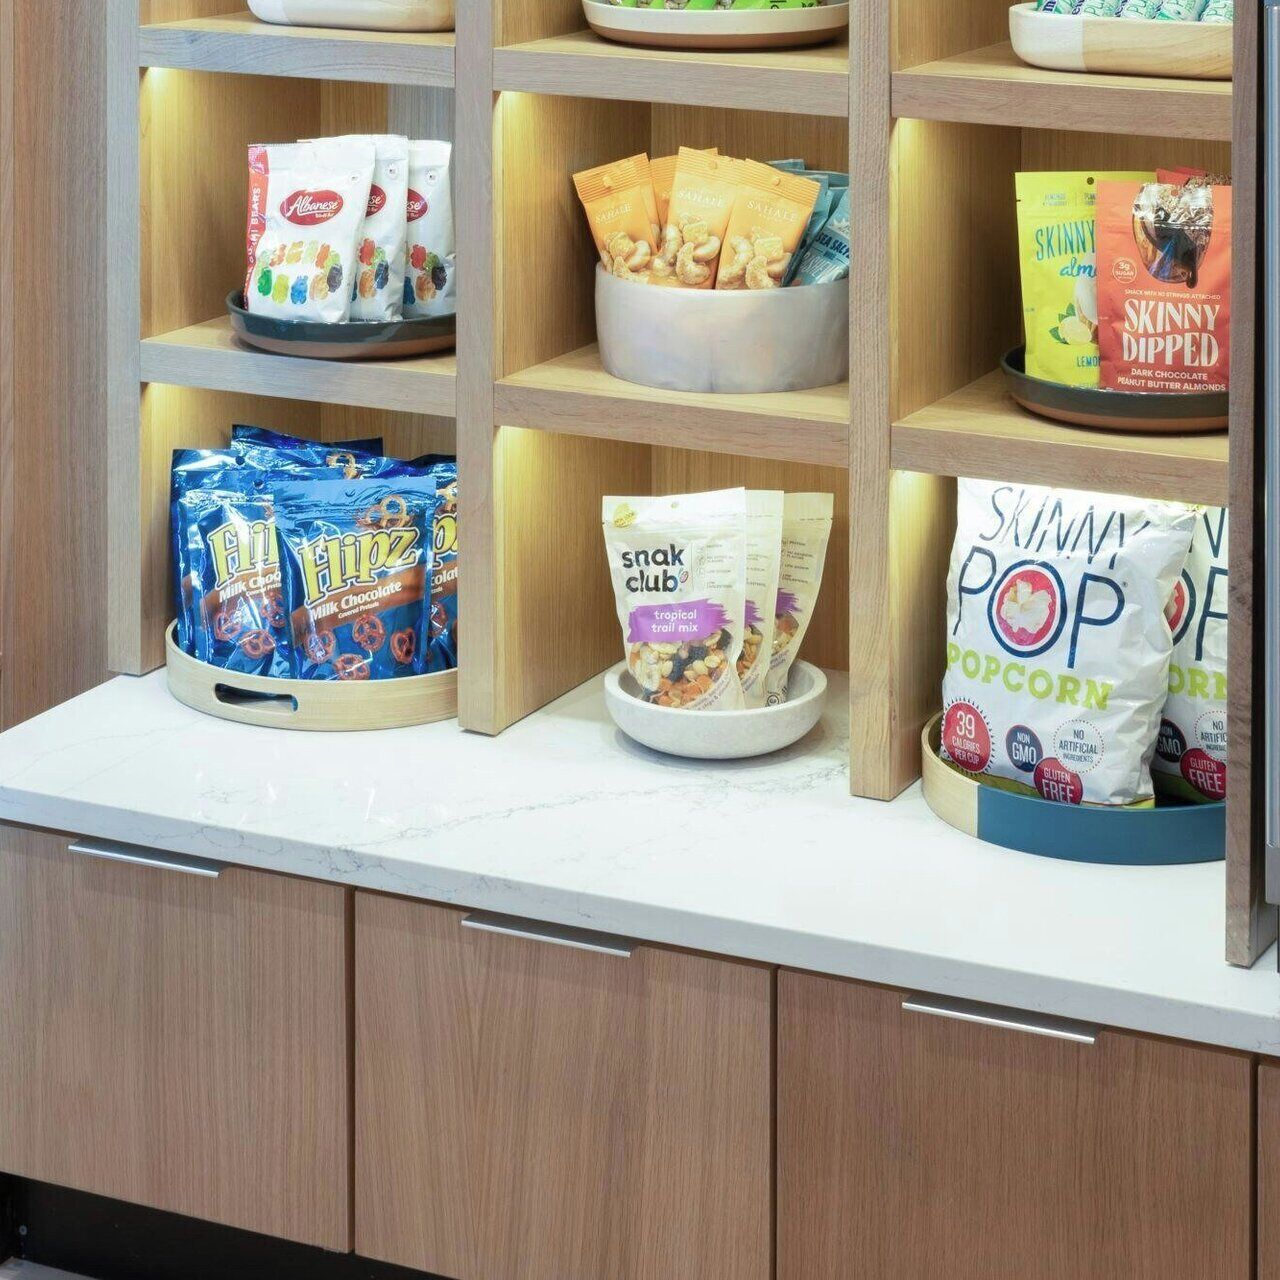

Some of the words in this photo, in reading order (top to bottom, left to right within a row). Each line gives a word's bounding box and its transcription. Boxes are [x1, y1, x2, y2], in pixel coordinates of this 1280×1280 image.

[285, 194, 339, 216] Albanese
[677, 189, 724, 207] SAHALE
[747, 200, 798, 222] SAHALE
[1035, 219, 1096, 261] SKINNY
[1124, 298, 1220, 334] SKINNY
[1122, 331, 1219, 367] DIPPED
[1117, 376, 1146, 387] PEANUT
[1147, 379, 1181, 390] BUTTER
[1182, 381, 1226, 391] ALMONDS
[1131, 368, 1154, 378] DARK
[1155, 370, 1208, 381] CHOCOLATE
[979, 486, 1150, 570] SKINNY
[622, 543, 685, 569] snak
[298, 527, 423, 609] Flipz
[625, 569, 679, 593] club
[219, 583, 248, 602] Milk
[311, 602, 339, 621] Milk
[340, 581, 403, 609] Chocolate
[338, 607, 358, 620] Covered
[356, 601, 380, 614] Pretzels
[654, 608, 698, 622] tropical
[953, 545, 1126, 669] POP
[651, 621, 676, 633] trail
[678, 622, 699, 633] mix
[946, 642, 1114, 711] POPCORN
[956, 710, 976, 739] 39
[1073, 729, 1085, 740] NO
[1212, 720, 1224, 731] NO
[951, 735, 981, 754] CALORIES
[1016, 731, 1031, 745] NON
[1058, 739, 1099, 755] ARTIFICIAL
[954, 747, 967, 761] PER
[967, 751, 980, 765] CUP
[1011, 742, 1037, 765] GMO
[1062, 753, 1094, 763] INGREDIENTS
[1043, 767, 1071, 782] GLUTEN
[1189, 757, 1218, 772] GLUTEN
[1188, 768, 1225, 793] FREE
[1041, 779, 1075, 804] FREE
